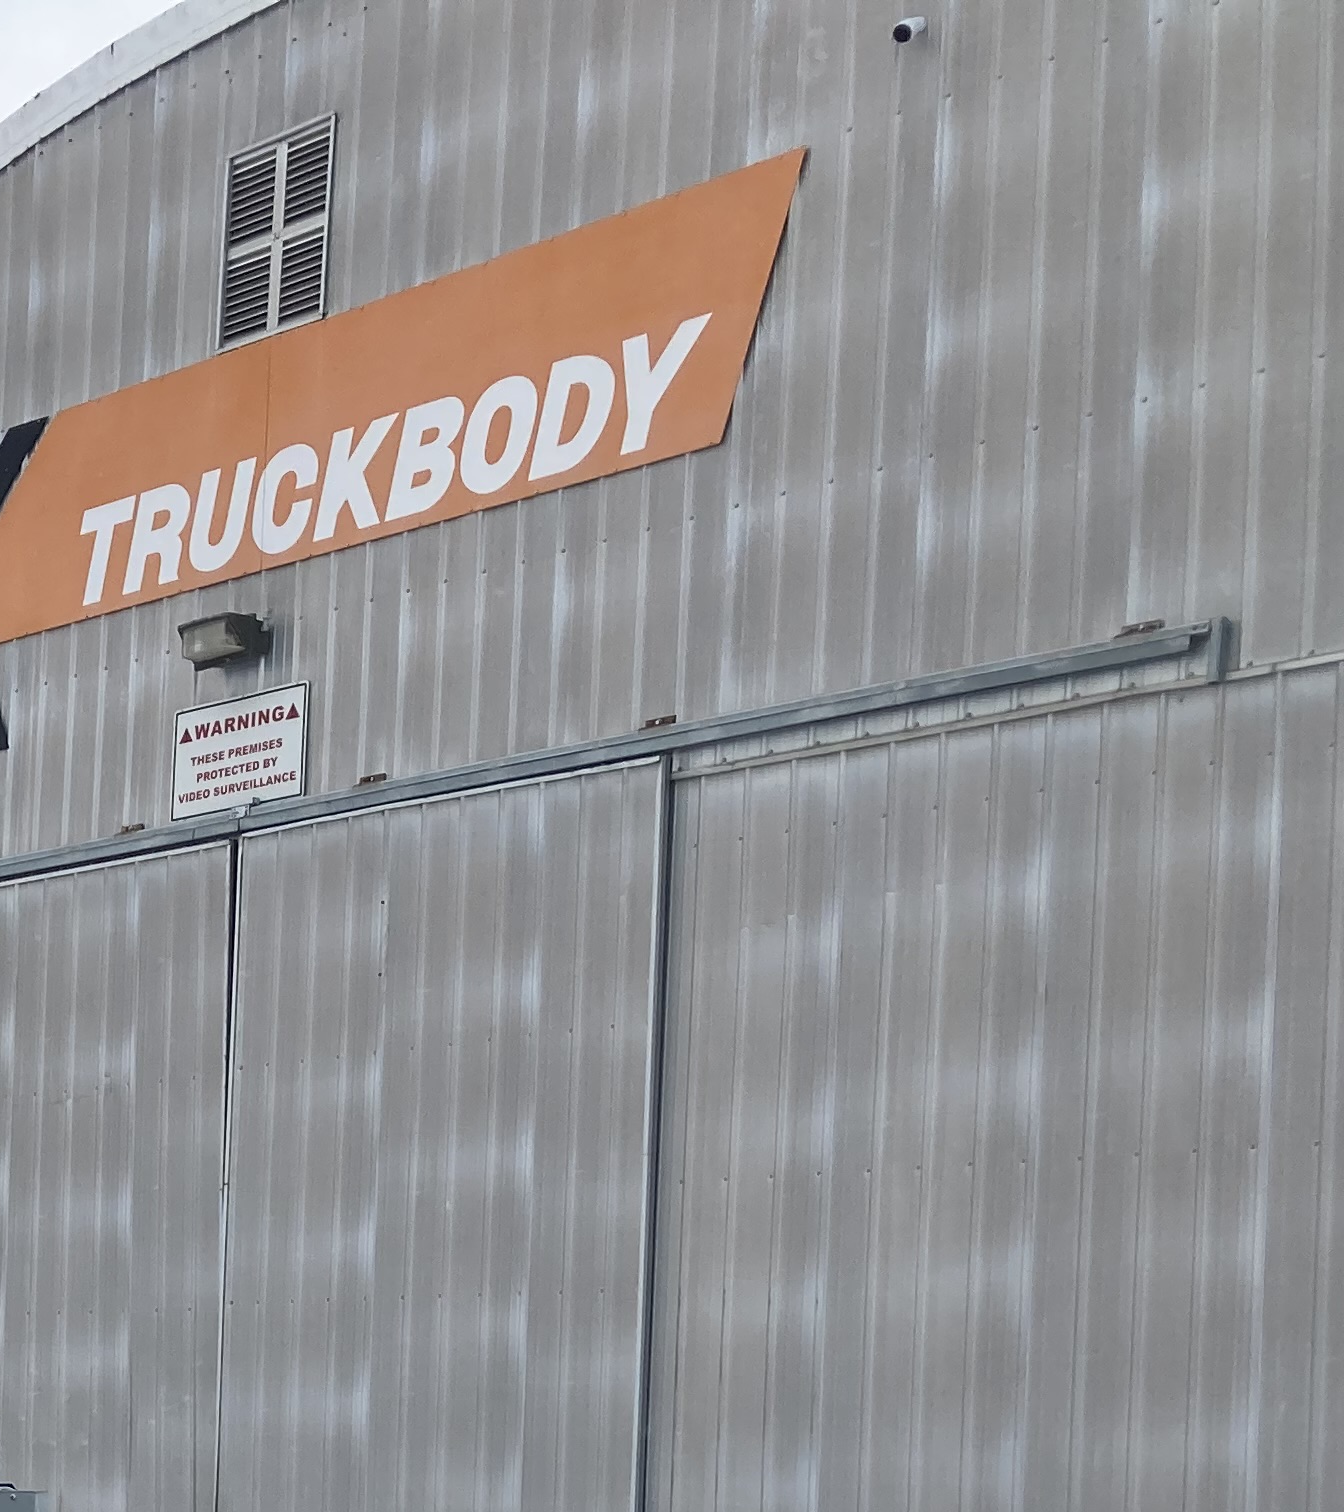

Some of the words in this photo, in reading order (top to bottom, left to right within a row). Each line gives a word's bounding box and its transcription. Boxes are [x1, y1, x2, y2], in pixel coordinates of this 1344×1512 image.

[79, 311, 713, 608] TRUCKBODY
[194, 705, 285, 740] WARNING
[190, 749, 225, 767] THESE
[228, 737, 283, 759] PREMISES
[178, 787, 211, 804] VIDEO
[213, 770, 297, 797] SURVEILLANCE
[196, 761, 260, 784] PROTECTED
[263, 756, 279, 769] BY
